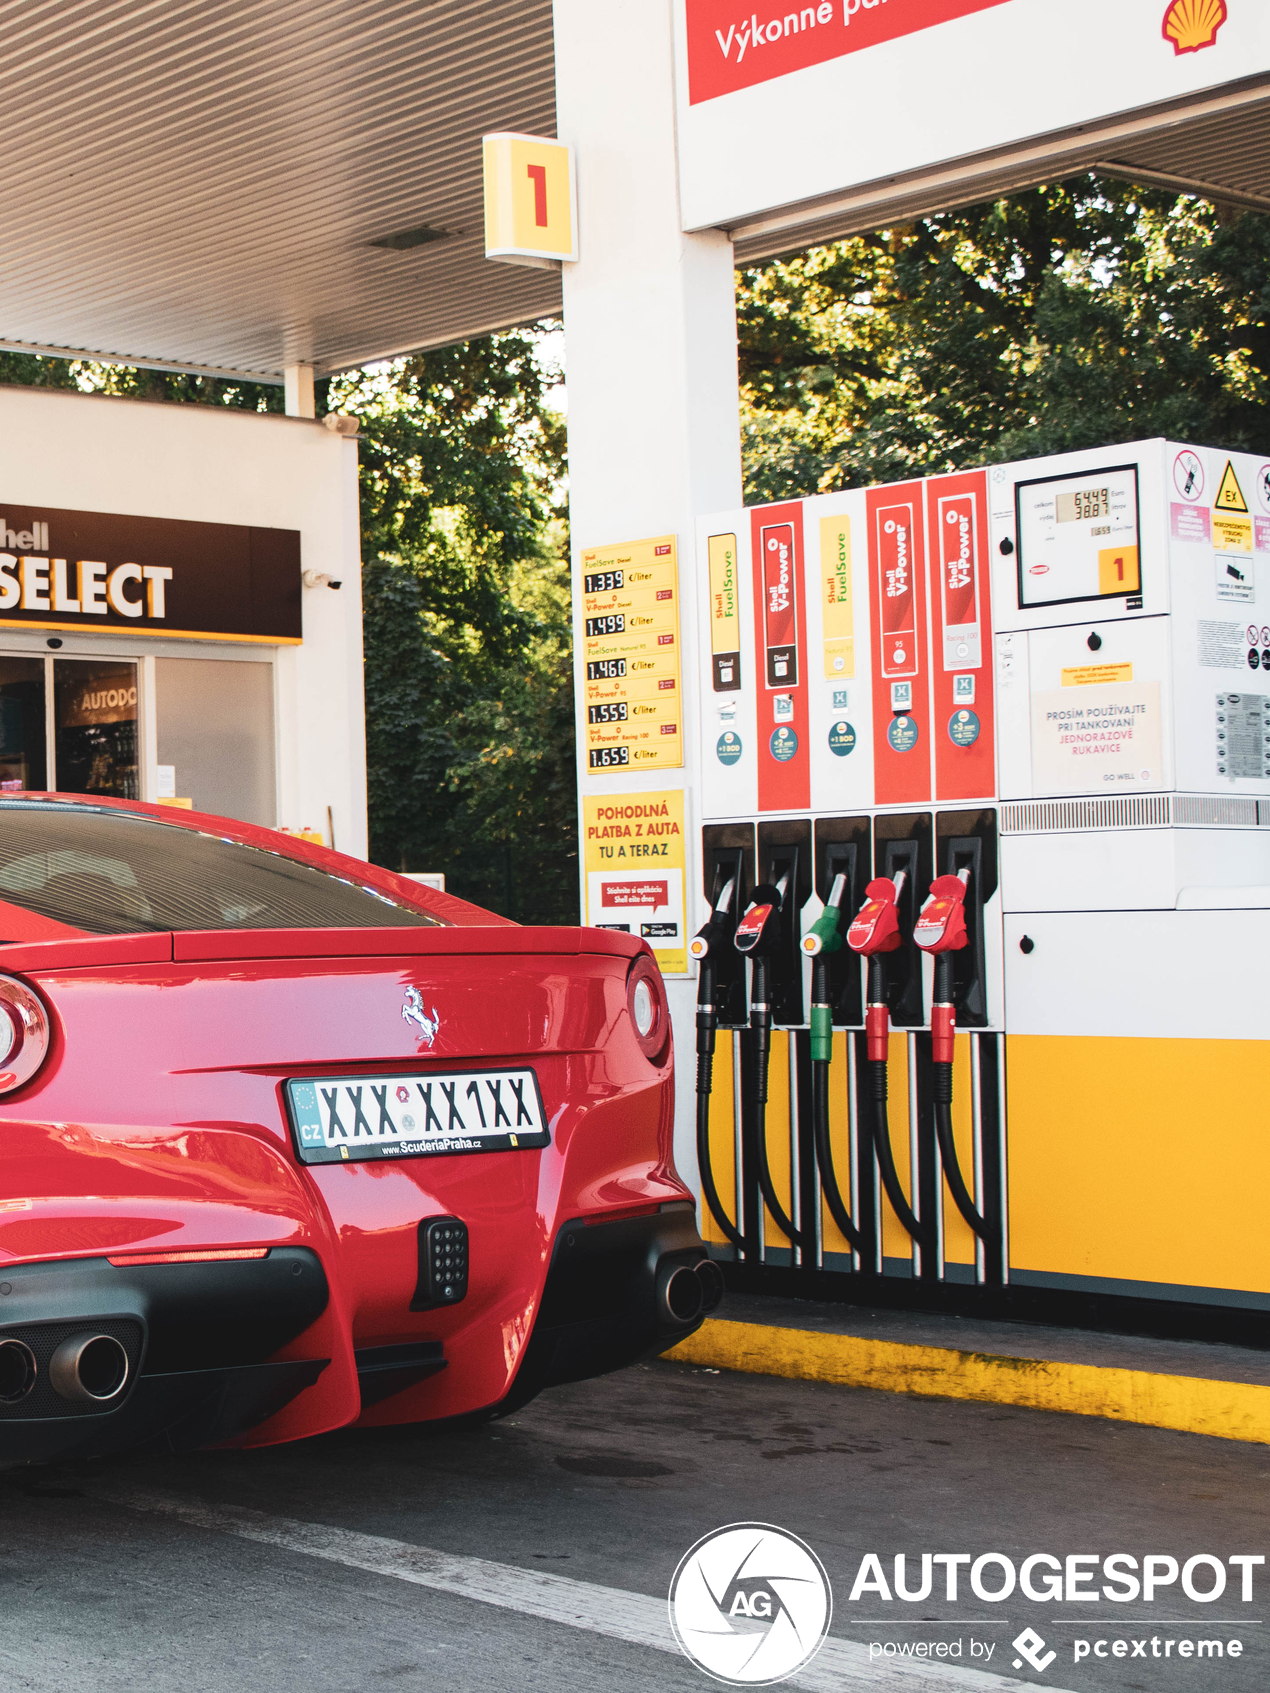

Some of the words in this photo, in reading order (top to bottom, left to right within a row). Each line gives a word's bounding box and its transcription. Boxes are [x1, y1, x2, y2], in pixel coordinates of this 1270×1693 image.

[714, 0, 834, 63] Výkonné
[527, 164, 548, 227] 1
[1225, 490, 1237, 503] EX
[895, 524, 908, 597] V-Power
[957, 514, 971, 588] V-Power
[585, 559, 615, 569] FuelSave
[836, 533, 847, 603] FuelSave
[1113, 557, 1124, 581] 1
[586, 570, 624, 592] 1.339
[628, 572, 653, 582] €/liter
[724, 550, 734, 618] FuelSave
[778, 542, 790, 611] V-Power
[886, 570, 896, 597] Shell
[948, 561, 958, 589] Shell
[769, 586, 779, 613] Shell
[828, 577, 836, 604] Shell
[586, 602, 615, 612] V-Power
[587, 614, 625, 636] 1.499
[630, 617, 654, 626] €/liter
[587, 646, 617, 656] FuelSave
[895, 640, 903, 648] 95
[588, 659, 627, 680] 1.460
[631, 661, 655, 671] €/liter
[588, 690, 617, 699] V-Power
[589, 703, 628, 724] 1.559
[632, 705, 657, 715] €/liter
[1046, 707, 1084, 721] PROSÍM
[1086, 704, 1147, 718] POUŽÍVAJTE
[1057, 722, 1073, 733] PRI
[1075, 715, 1134, 731] TANKOVANÍ
[590, 734, 619, 743] V-Power
[1059, 728, 1133, 744] JEDNORAZOVÉ
[591, 747, 629, 767] 1.659
[634, 750, 658, 760] €/liter
[1071, 744, 1121, 755] RUKAVICE
[597, 800, 669, 820] POHODLNÁ
[588, 824, 632, 839] PLATBA
[635, 824, 643, 837] Z
[646, 822, 680, 836] AUTA
[599, 846, 613, 858] TU
[618, 845, 626, 857] A
[630, 843, 669, 857] TERAZ
[320, 1084, 398, 1139] XXX
[416, 1078, 534, 1132] XX1XX
[301, 1124, 321, 1140] CZ
[381, 1134, 482, 1155] www.ScuderiaPraha.cz
